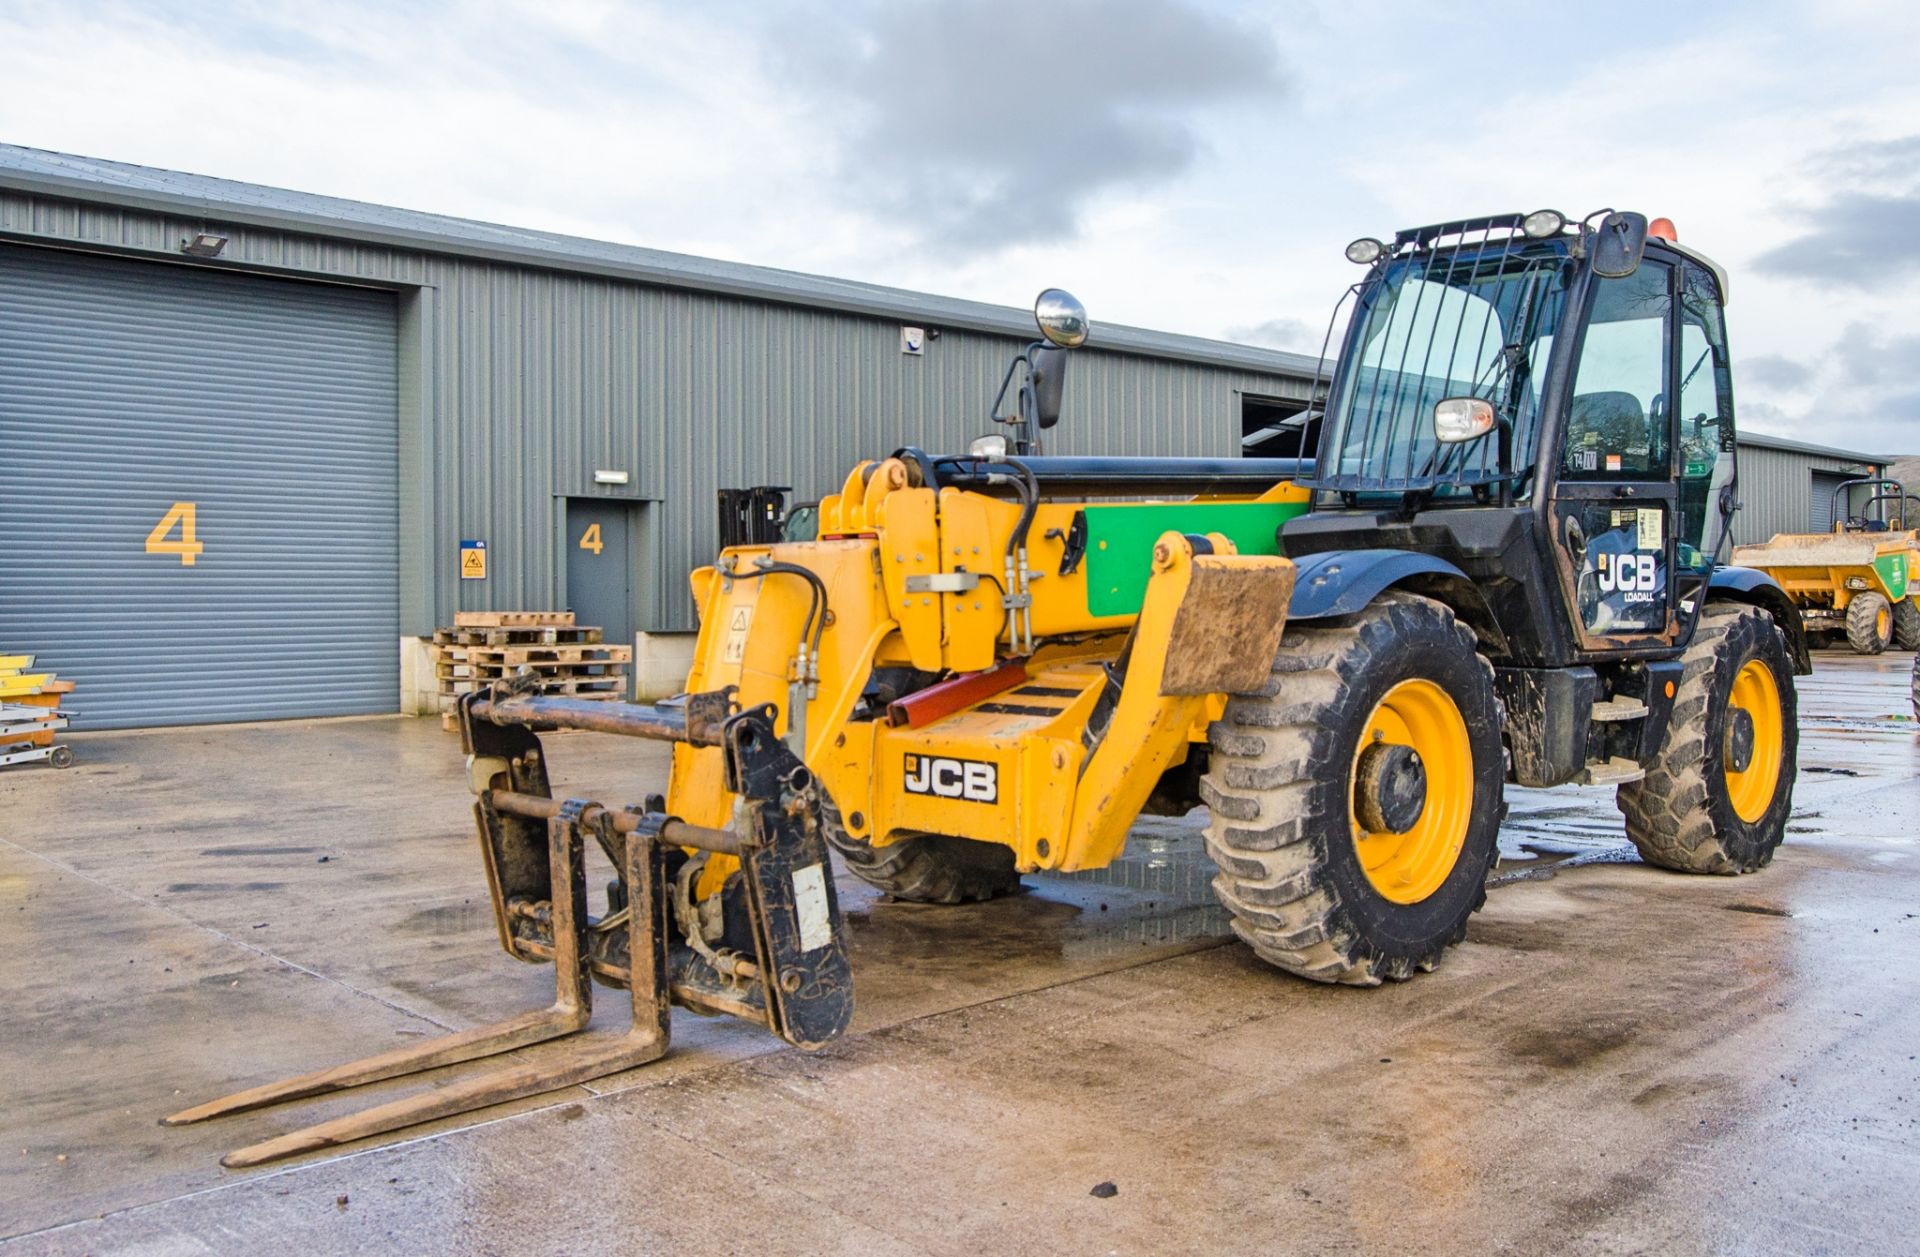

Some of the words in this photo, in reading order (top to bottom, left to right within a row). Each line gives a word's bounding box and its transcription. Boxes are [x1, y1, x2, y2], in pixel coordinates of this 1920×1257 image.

[145, 502, 204, 566] 4
[580, 523, 604, 555] 4
[1598, 554, 1656, 592] JCB
[1624, 592, 1654, 602] LOADALL
[905, 756, 997, 801] JCB
